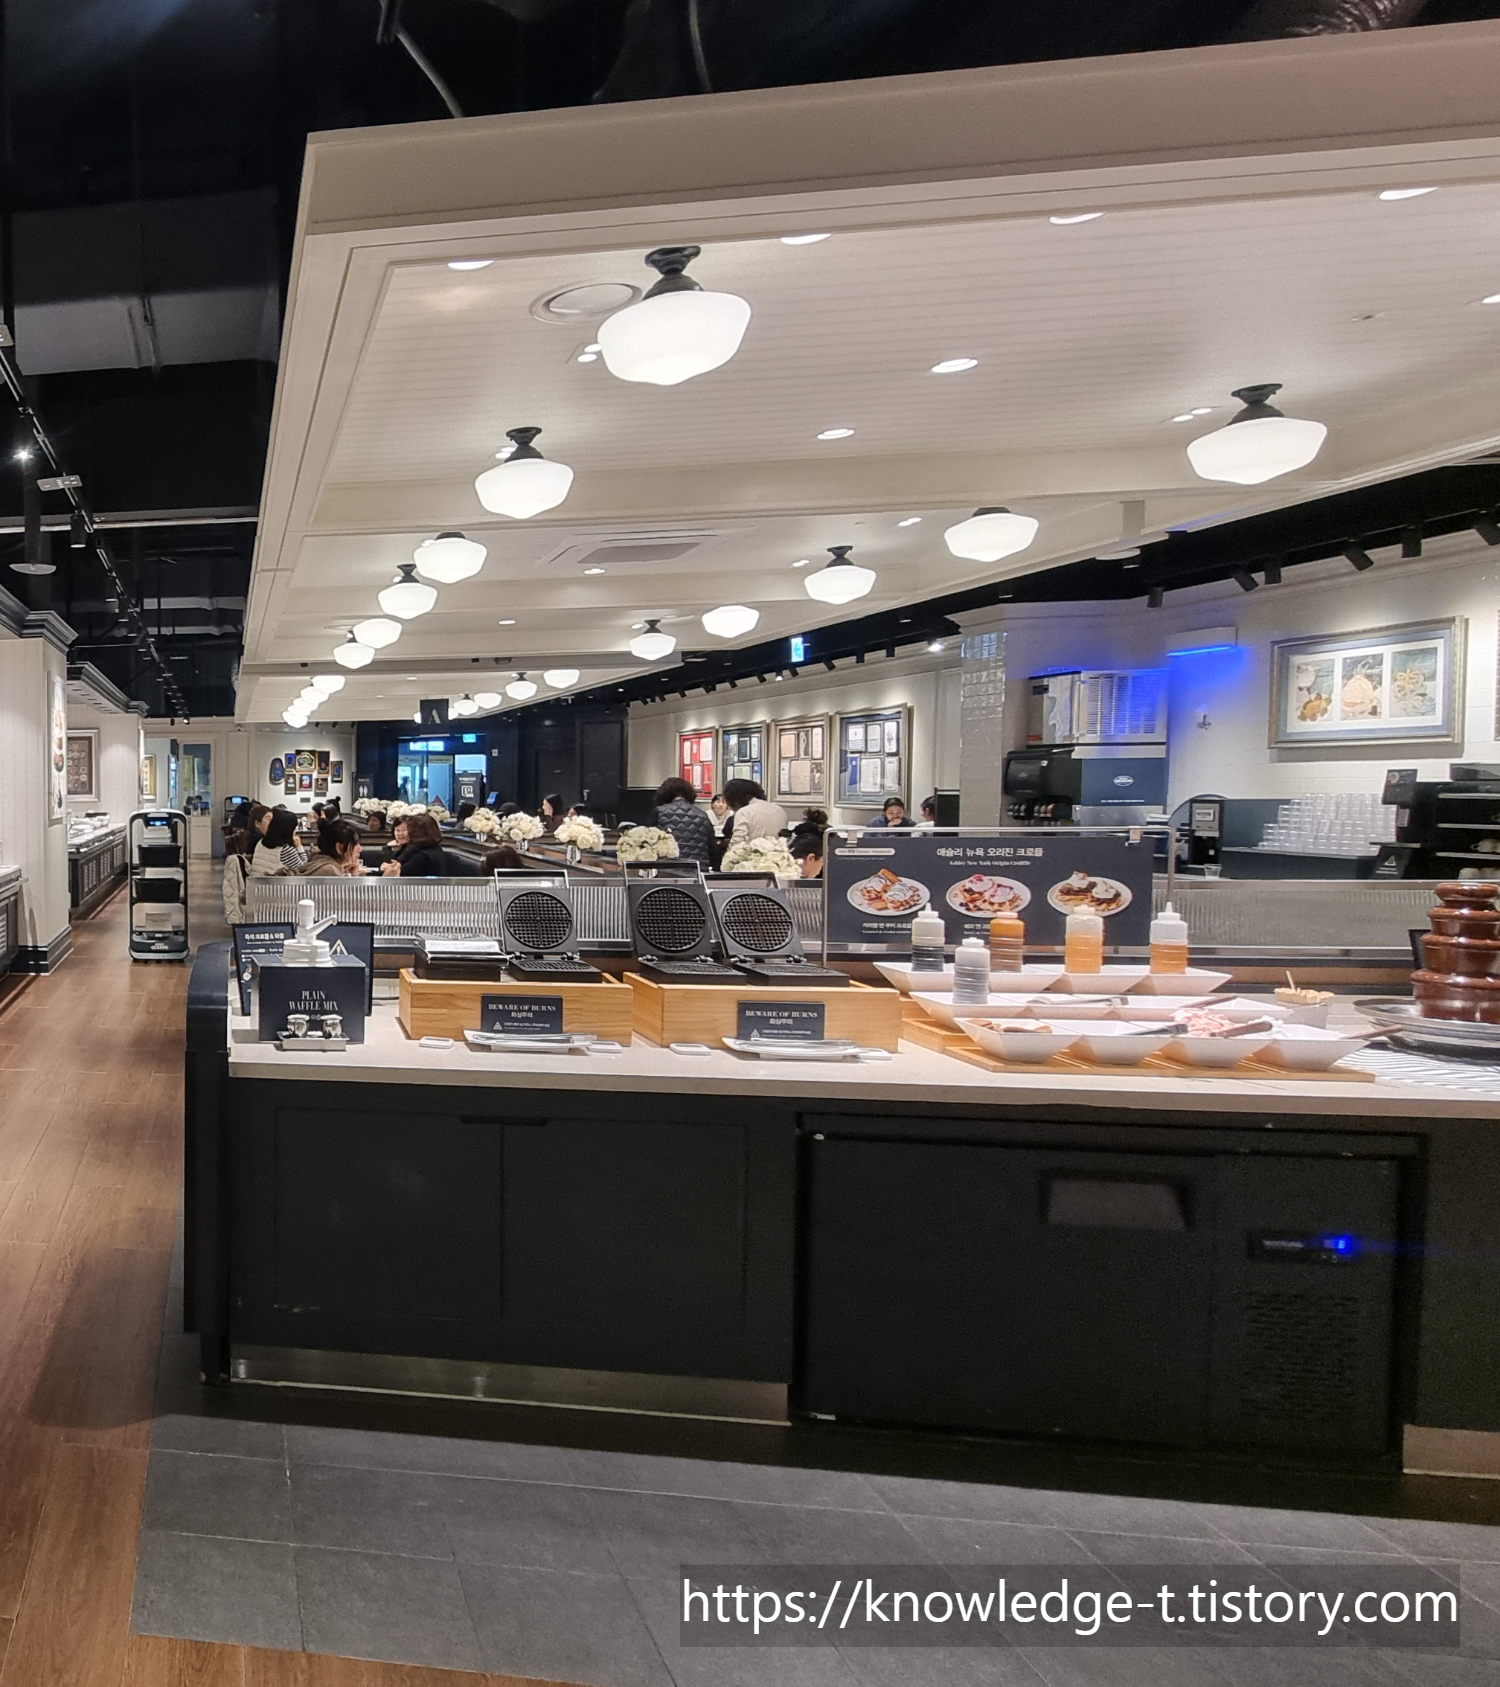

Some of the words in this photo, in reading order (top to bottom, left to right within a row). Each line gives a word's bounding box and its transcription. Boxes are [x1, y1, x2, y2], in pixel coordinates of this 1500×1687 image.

[965, 847, 985, 857] 뉴욕
[987, 847, 1014, 857] 오리진
[301, 990, 326, 1000] PLAIN
[288, 1000, 321, 1010] WAFFLE
[322, 1000, 339, 1011] MIX
[488, 1003, 519, 1011] BEWARE
[531, 1004, 556, 1012] BURNS
